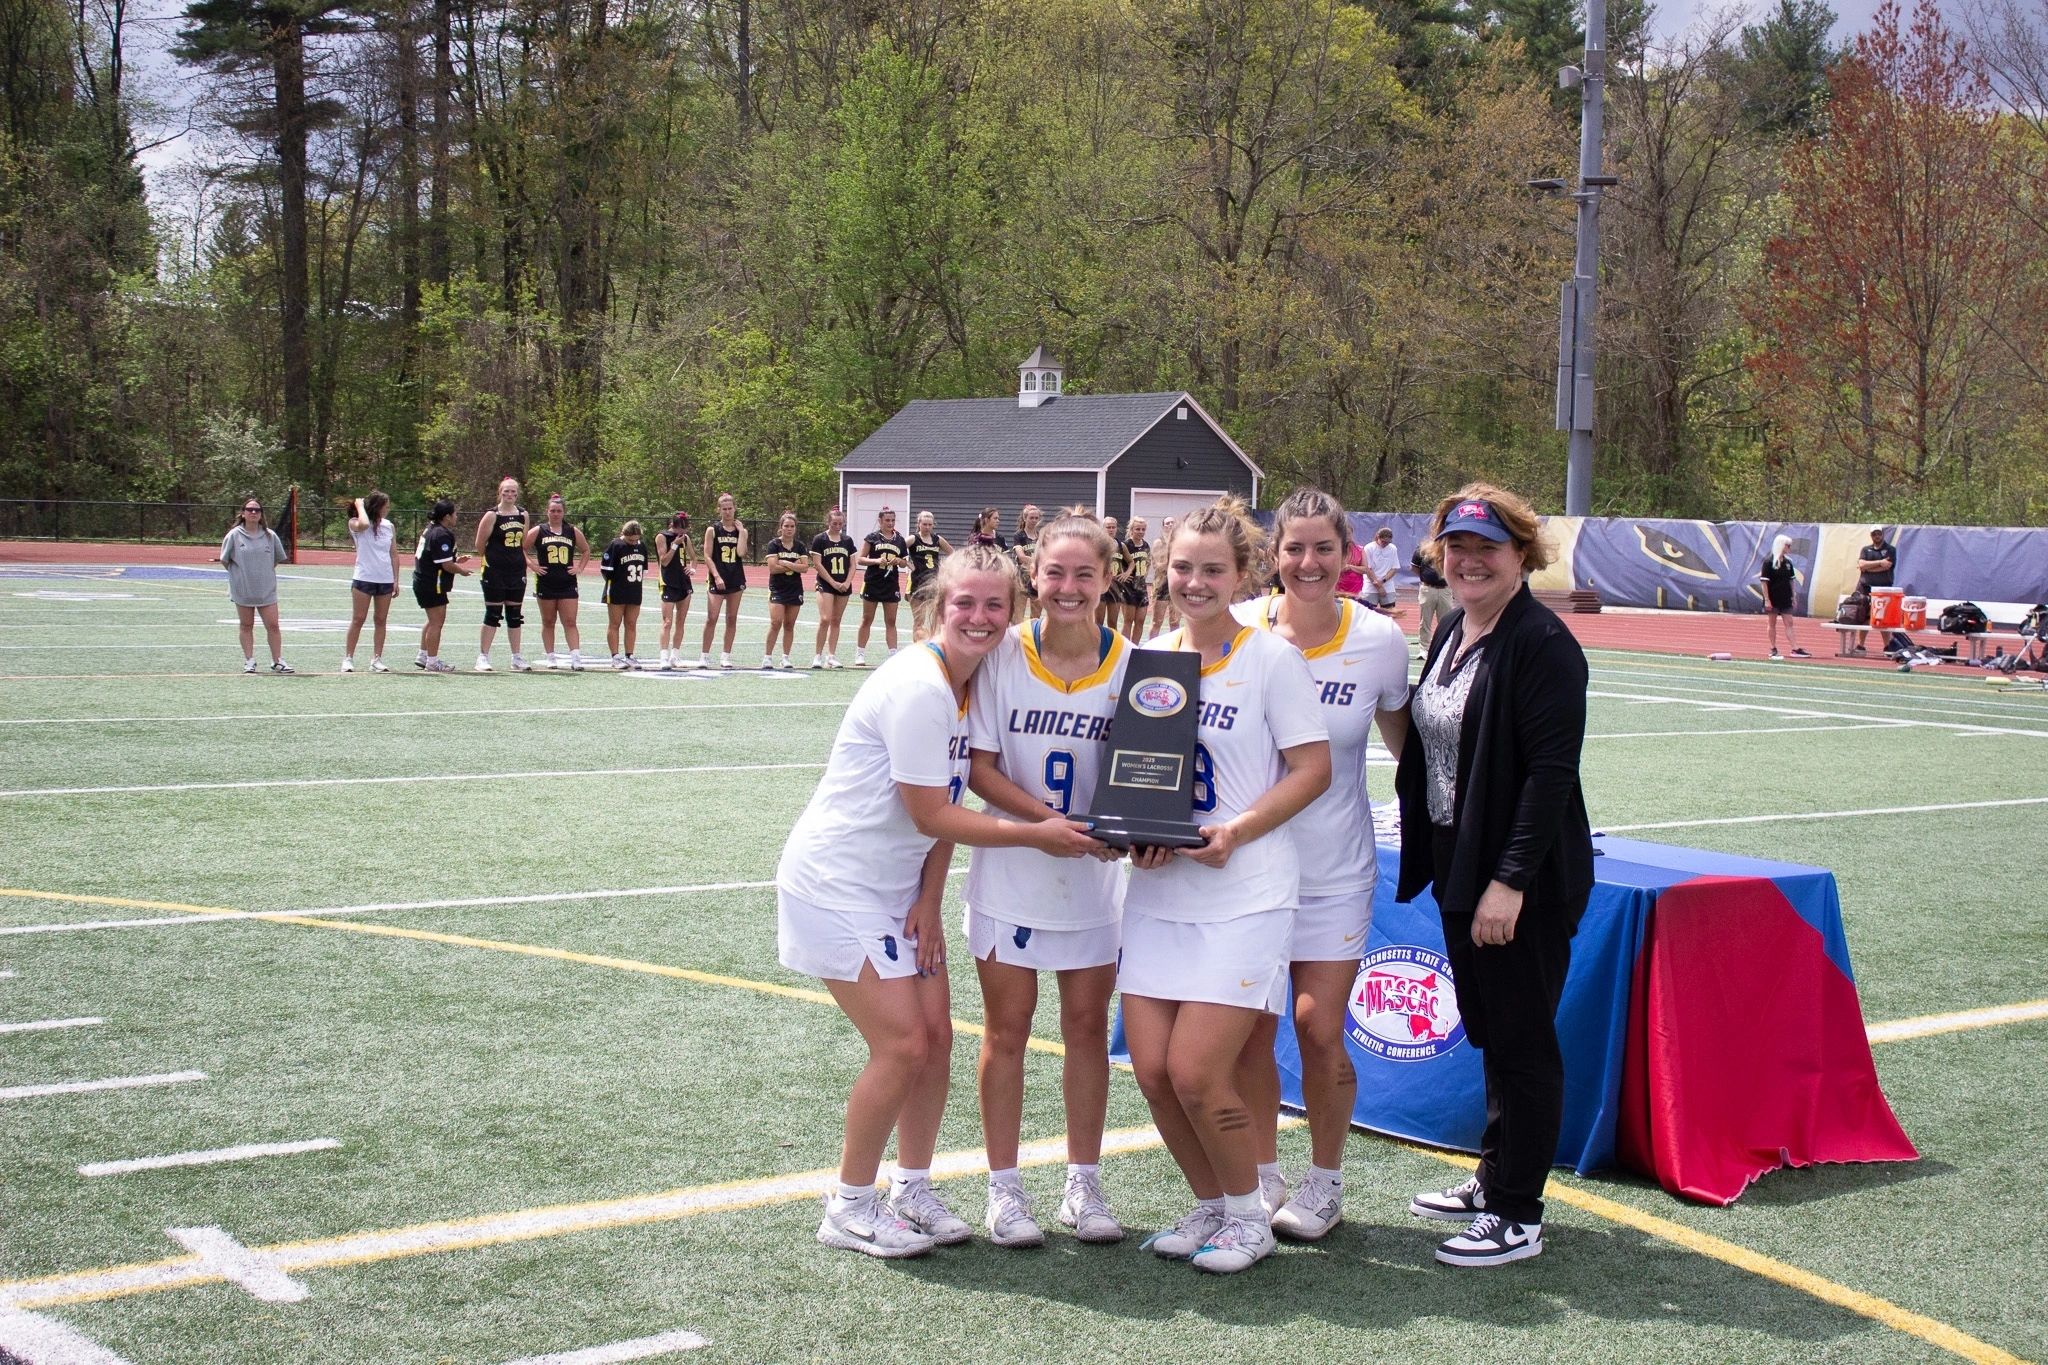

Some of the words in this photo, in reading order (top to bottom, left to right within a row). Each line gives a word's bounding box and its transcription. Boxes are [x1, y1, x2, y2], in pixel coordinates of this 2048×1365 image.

[547, 545, 569, 565] 20
[721, 545, 737, 564] 21
[627, 564, 643, 583] 33
[830, 556, 845, 575] 11
[1009, 708, 1114, 742] LANCERS
[1147, 764, 1174, 772] LACROSSE
[1042, 748, 1077, 816] 9
[1131, 776, 1159, 784] CHAMPION
[1359, 949, 1412, 972] SACHUSETTS
[1415, 952, 1440, 967] STATE
[1365, 979, 1439, 1020] MASCAC
[1351, 1027, 1384, 1053] ATHLETIC
[1386, 1044, 1437, 1058] CONFERENCE
